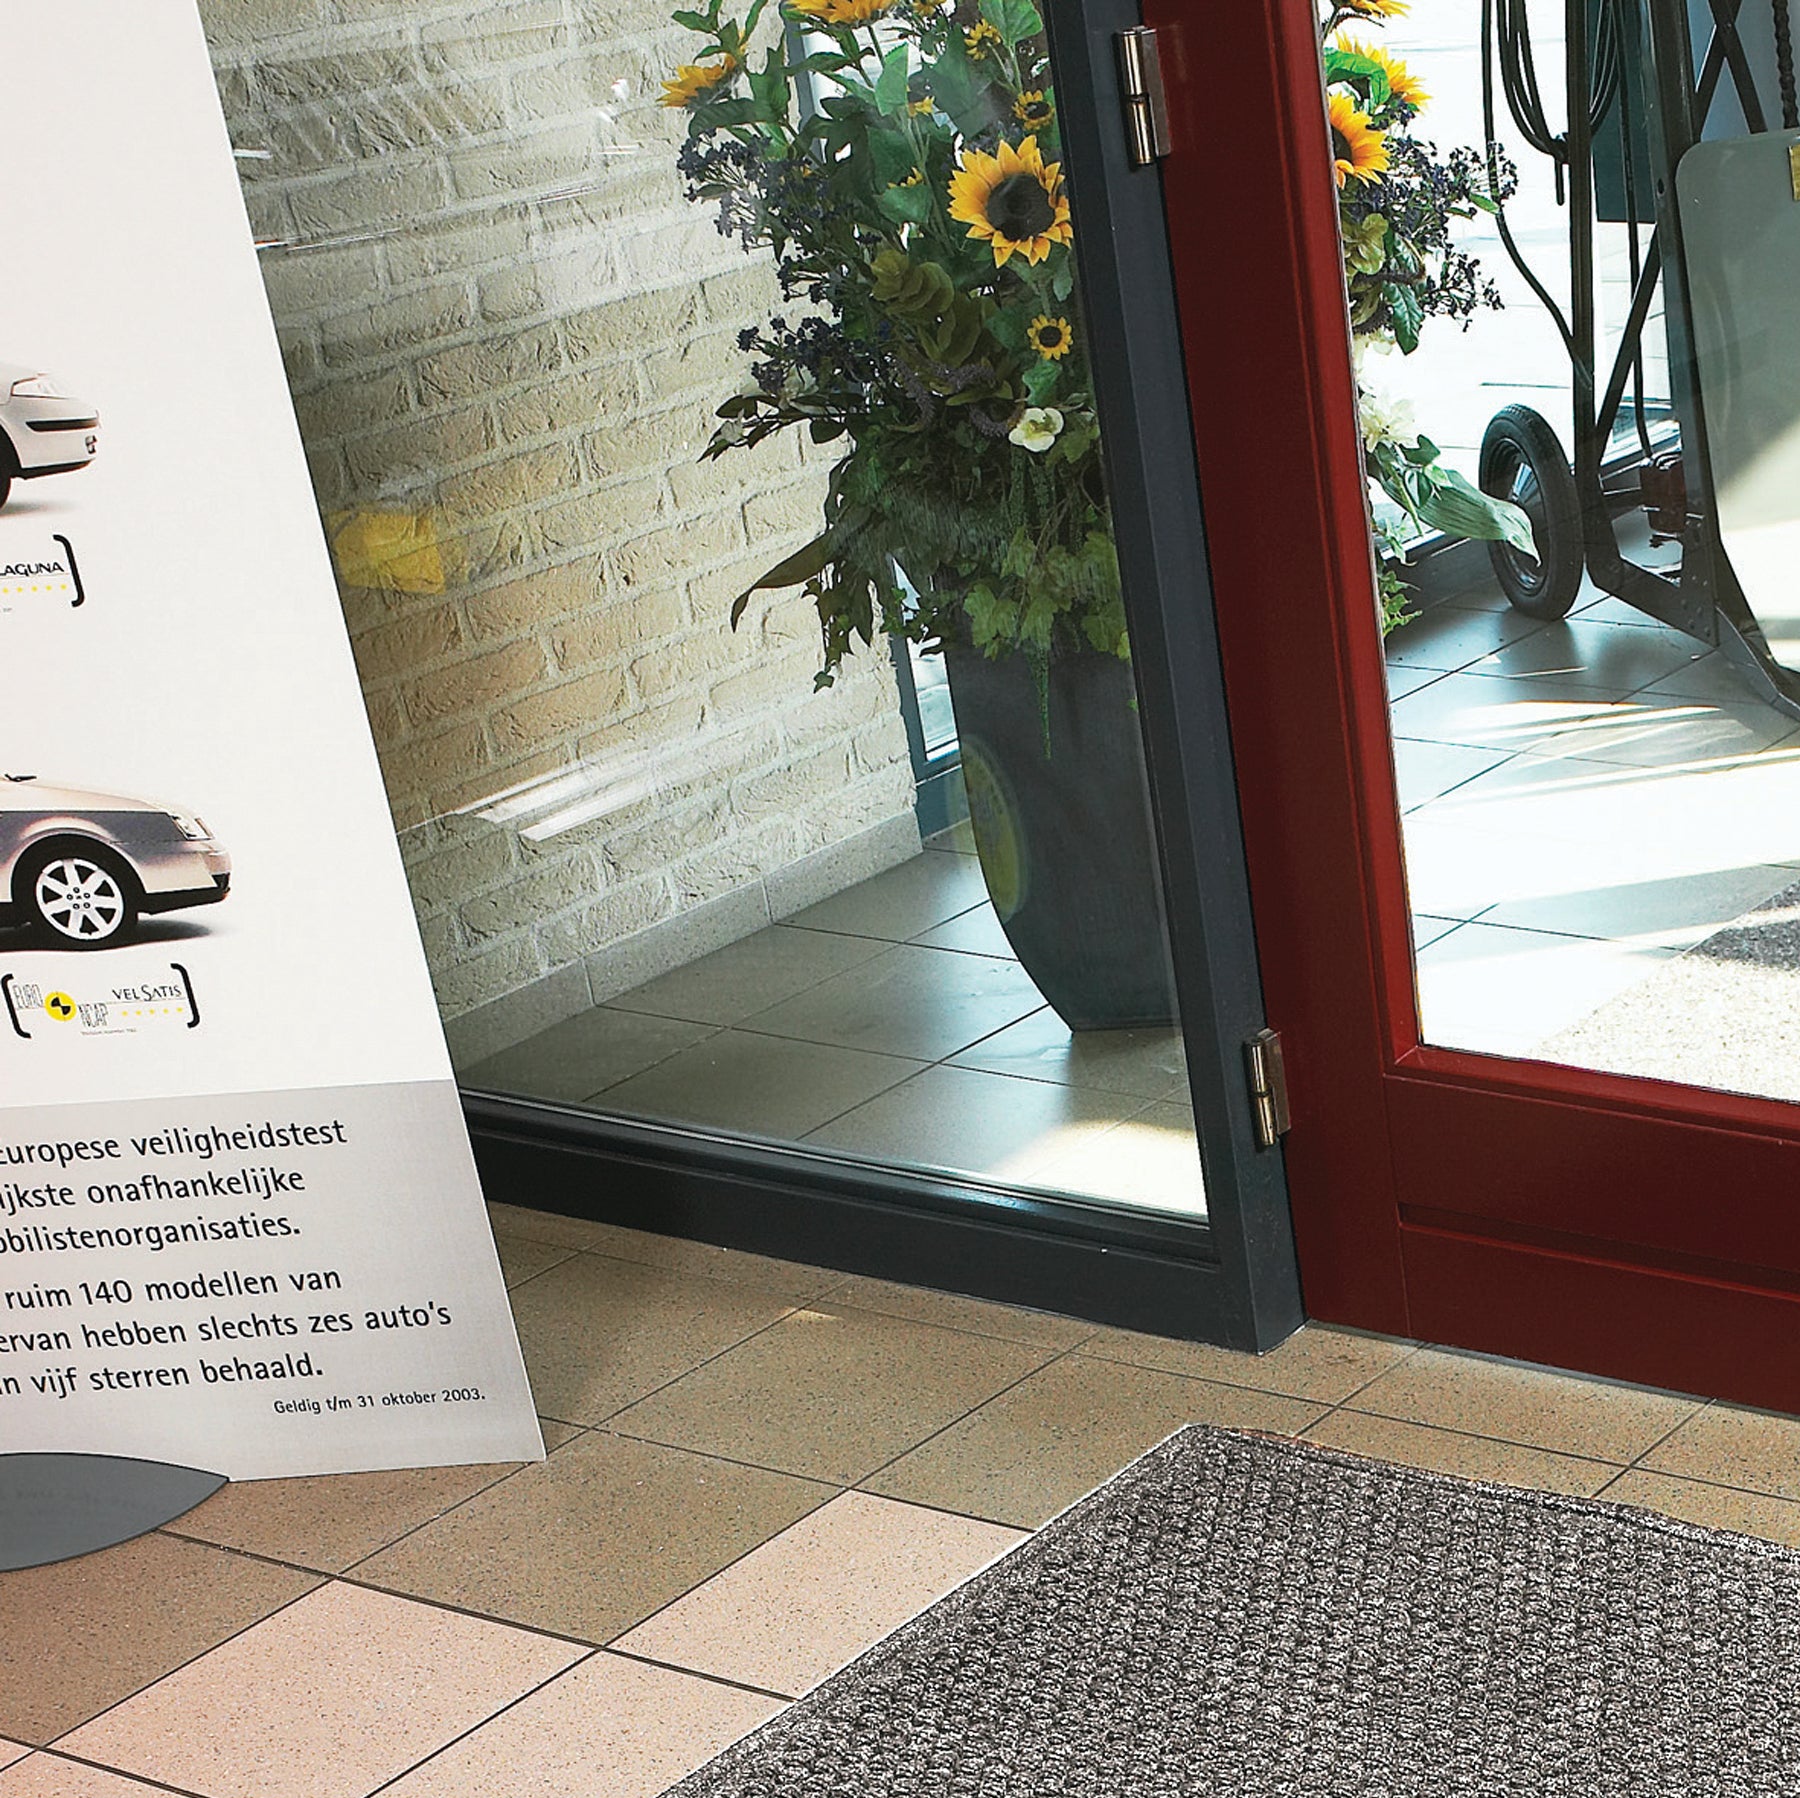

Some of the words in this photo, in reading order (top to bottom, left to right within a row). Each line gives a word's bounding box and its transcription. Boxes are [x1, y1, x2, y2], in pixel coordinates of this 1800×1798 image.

[130, 1119, 348, 1160] veiligheidstest
[87, 1166, 306, 1205] onafhankelijke
[4, 1282, 73, 1310] ruim
[78, 1279, 133, 1306] 140
[144, 1270, 278, 1303] modellen
[288, 1271, 342, 1293] van
[80, 1320, 187, 1349] hebben
[197, 1310, 299, 1341] slechts
[309, 1313, 353, 1334] zes
[364, 1300, 452, 1330] auto's
[30, 1366, 77, 1399] vijf
[89, 1366, 190, 1392] sterren
[199, 1352, 324, 1385] behaald.
[273, 1398, 322, 1415] Geldig
[325, 1395, 353, 1412] t/m
[356, 1395, 376, 1408] 31
[381, 1391, 437, 1407] oktober
[441, 1387, 487, 1403] 2003.
